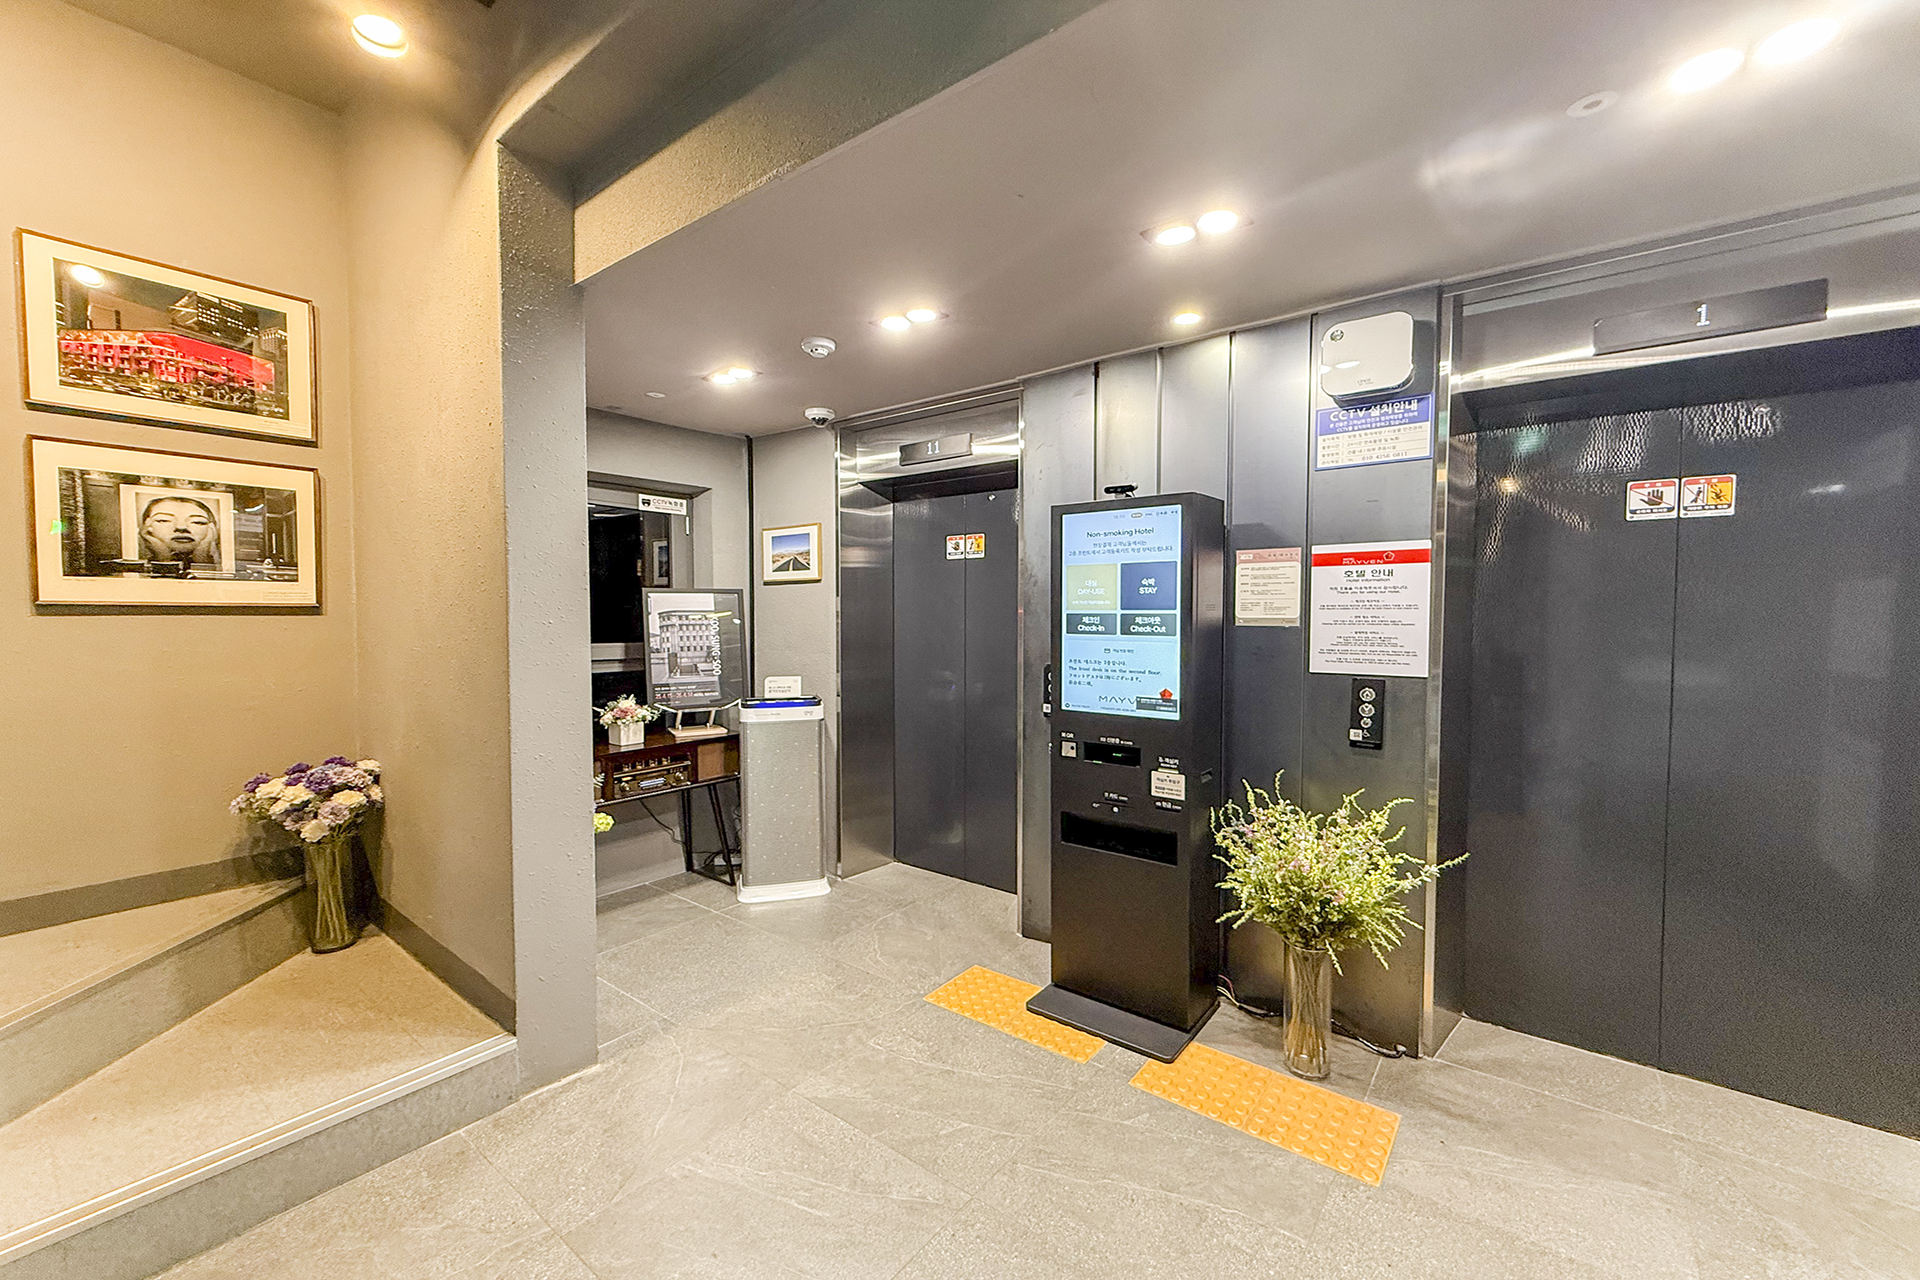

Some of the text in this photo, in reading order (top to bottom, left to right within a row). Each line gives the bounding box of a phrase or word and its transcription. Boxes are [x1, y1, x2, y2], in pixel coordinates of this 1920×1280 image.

[1696, 303, 1711, 327] 1
[1330, 399, 1418, 421] CCTV 설치안내
[926, 441, 940, 455] 11
[1086, 527, 1155, 538] Non-smoking Hotel
[1344, 568, 1394, 578] 호텔 안내
[1141, 578, 1156, 586] 숙박
[1077, 588, 1106, 596] DAY-USE
[1138, 586, 1158, 594] STAY
[1082, 616, 1100, 624] 체크인
[1134, 616, 1162, 625] 체크아웃
[1077, 624, 1106, 632] Check-In
[1130, 624, 1167, 633] Check-Out
[1098, 695, 1137, 705] MAYV
